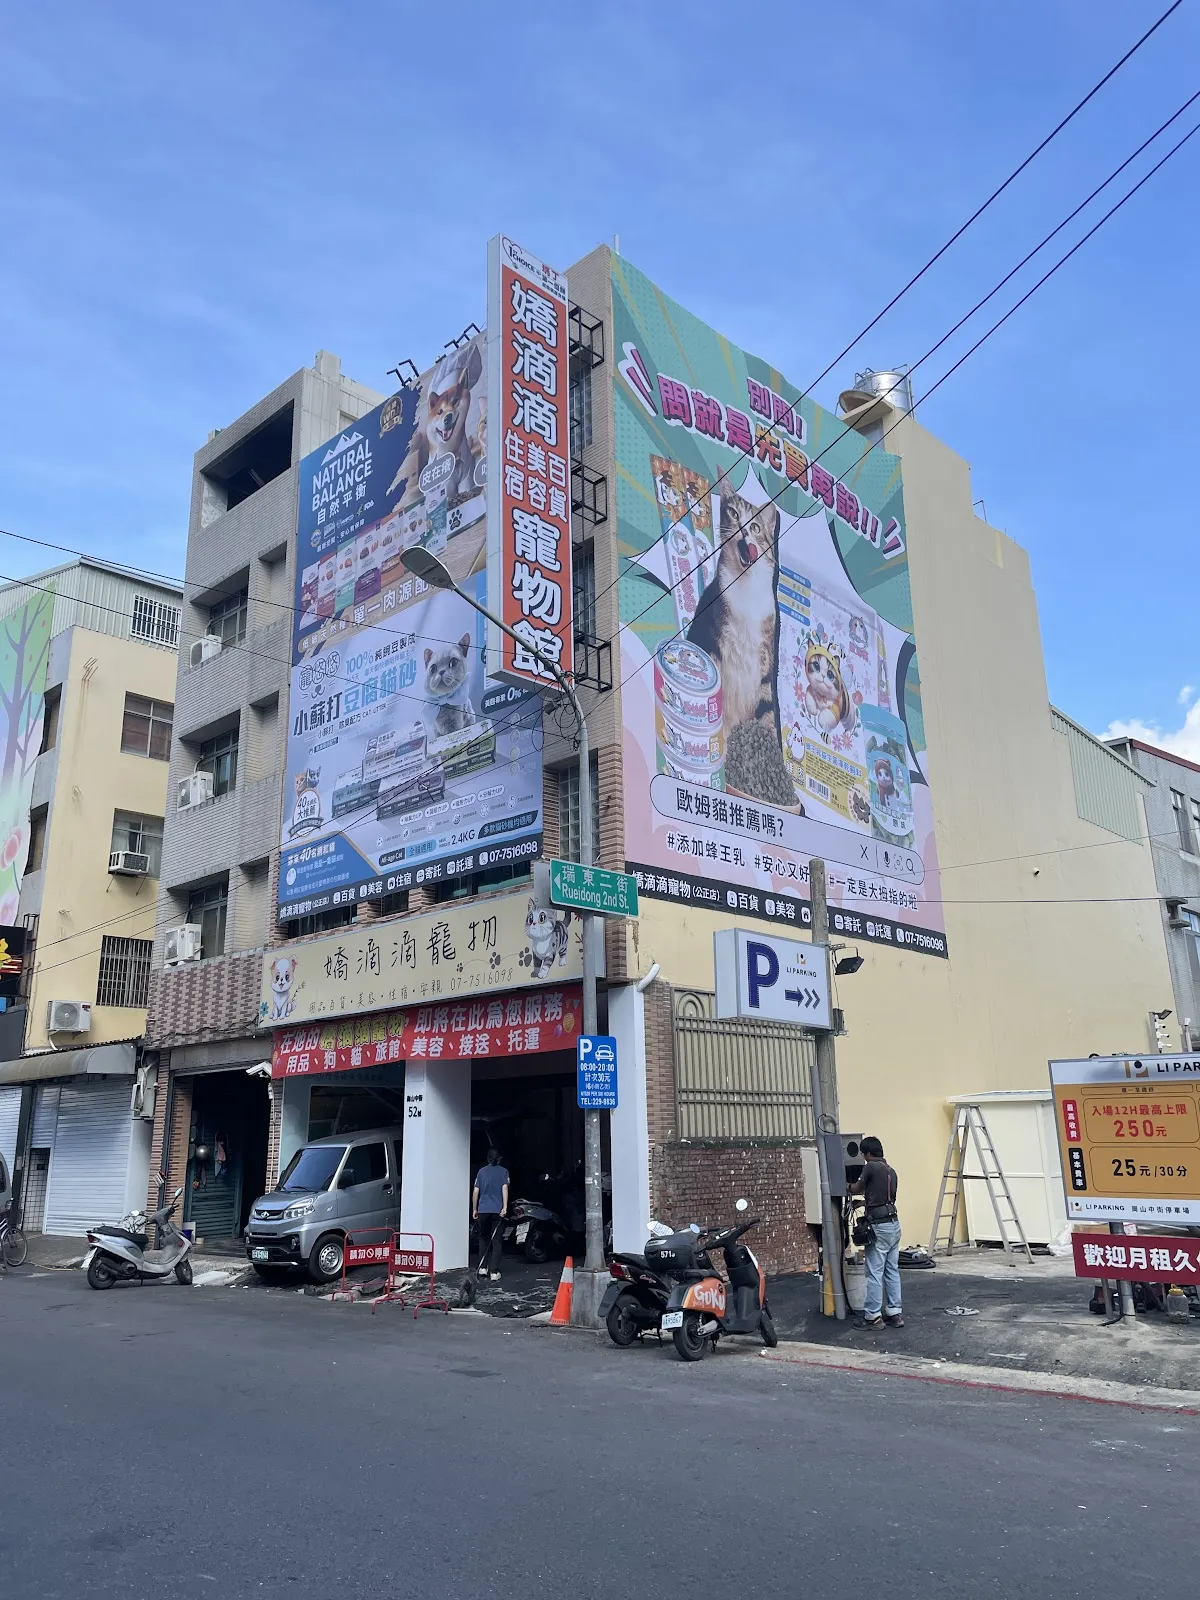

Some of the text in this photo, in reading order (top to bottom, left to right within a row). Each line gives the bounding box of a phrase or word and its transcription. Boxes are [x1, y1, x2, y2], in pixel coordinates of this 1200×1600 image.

[512, 253, 536, 273] CHOICE
[510, 279, 558, 447] 嬌滴滴
[746, 377, 804, 441] 別問!
[312, 439, 373, 495] NATURAL
[421, 457, 451, 487] 皮在癢
[504, 428, 525, 501] 住宿
[527, 441, 546, 511] 美容
[312, 459, 373, 511] BALANCE
[547, 451, 567, 523] 百貨
[317, 481, 367, 525] 自然平衡
[353, 577, 436, 627] 單一肉源配
[511, 506, 564, 680] 寵物館
[345, 648, 374, 675] 100%
[676, 787, 784, 838] 歐姆貓推薦嗎?
[451, 829, 475, 846] 2.4KG
[489, 840, 538, 863] 07-7516098
[667, 832, 746, 867] #添加蜂王乳
[754, 854, 811, 883] #安心又好
[367, 881, 383, 895] 美容
[396, 872, 412, 887] 住宿
[561, 864, 628, 894] 瑞東二街
[341, 888, 356, 903] 百貨
[561, 882, 630, 909] Rueidong 2nd St.
[738, 892, 760, 912] 百貨
[775, 899, 796, 920] 美容
[904, 930, 944, 952] 07-7516098
[450, 967, 513, 991] 07-7516098
[747, 940, 780, 1009] P
[792, 967, 817, 978] PARKING
[580, 1038, 593, 1061] P
[580, 1062, 614, 1072] 08:00-20:00
[1157, 1062, 1169, 1073] LI
[1091, 1103, 1187, 1116] 入場12H最高上限
[1113, 1119, 1167, 1138] 250元
